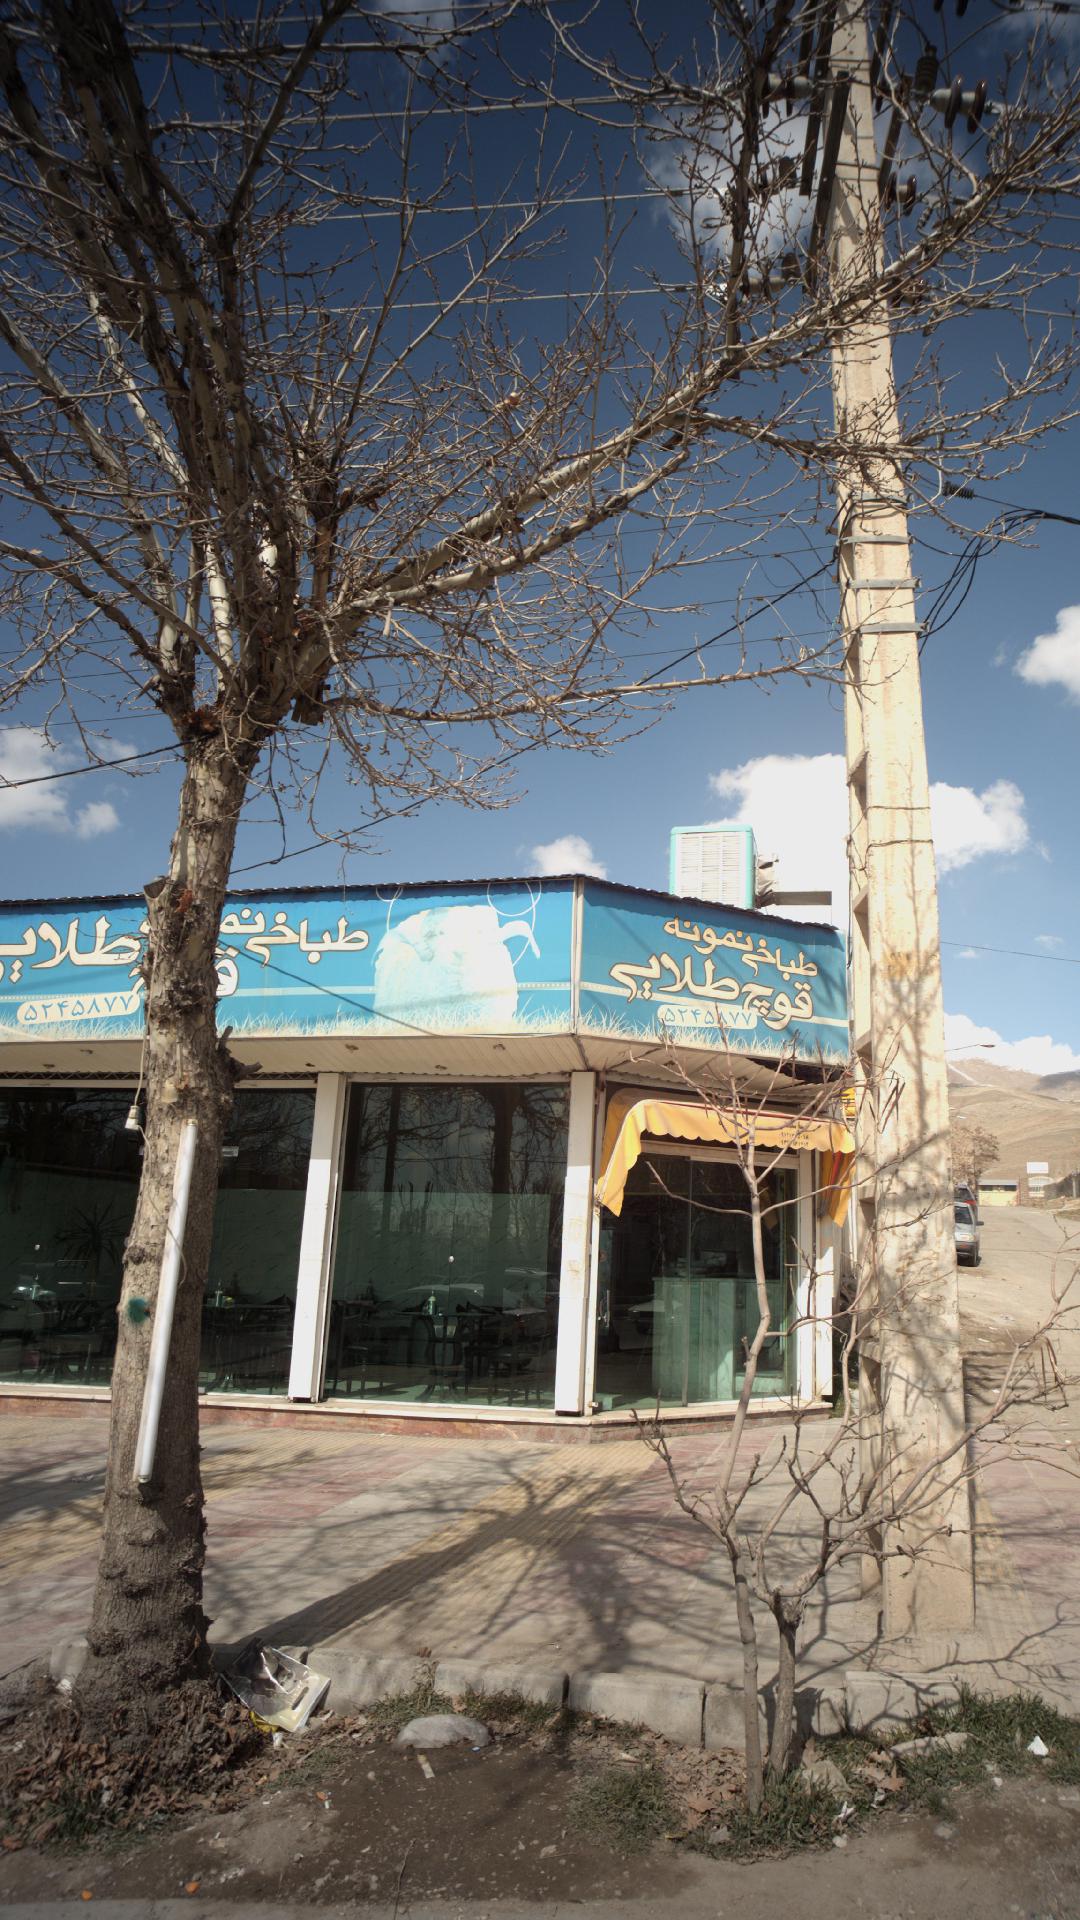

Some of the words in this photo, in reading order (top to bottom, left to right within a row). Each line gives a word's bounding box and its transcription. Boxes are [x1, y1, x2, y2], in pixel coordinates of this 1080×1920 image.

[662, 915, 755, 955] نمونه
[24, 995, 134, 1022] ۵۲۴۵۸۷۷
[664, 1007, 752, 1026] ۵۲۴۵۸۷۷
[740, 980, 815, 1031] قوچ
